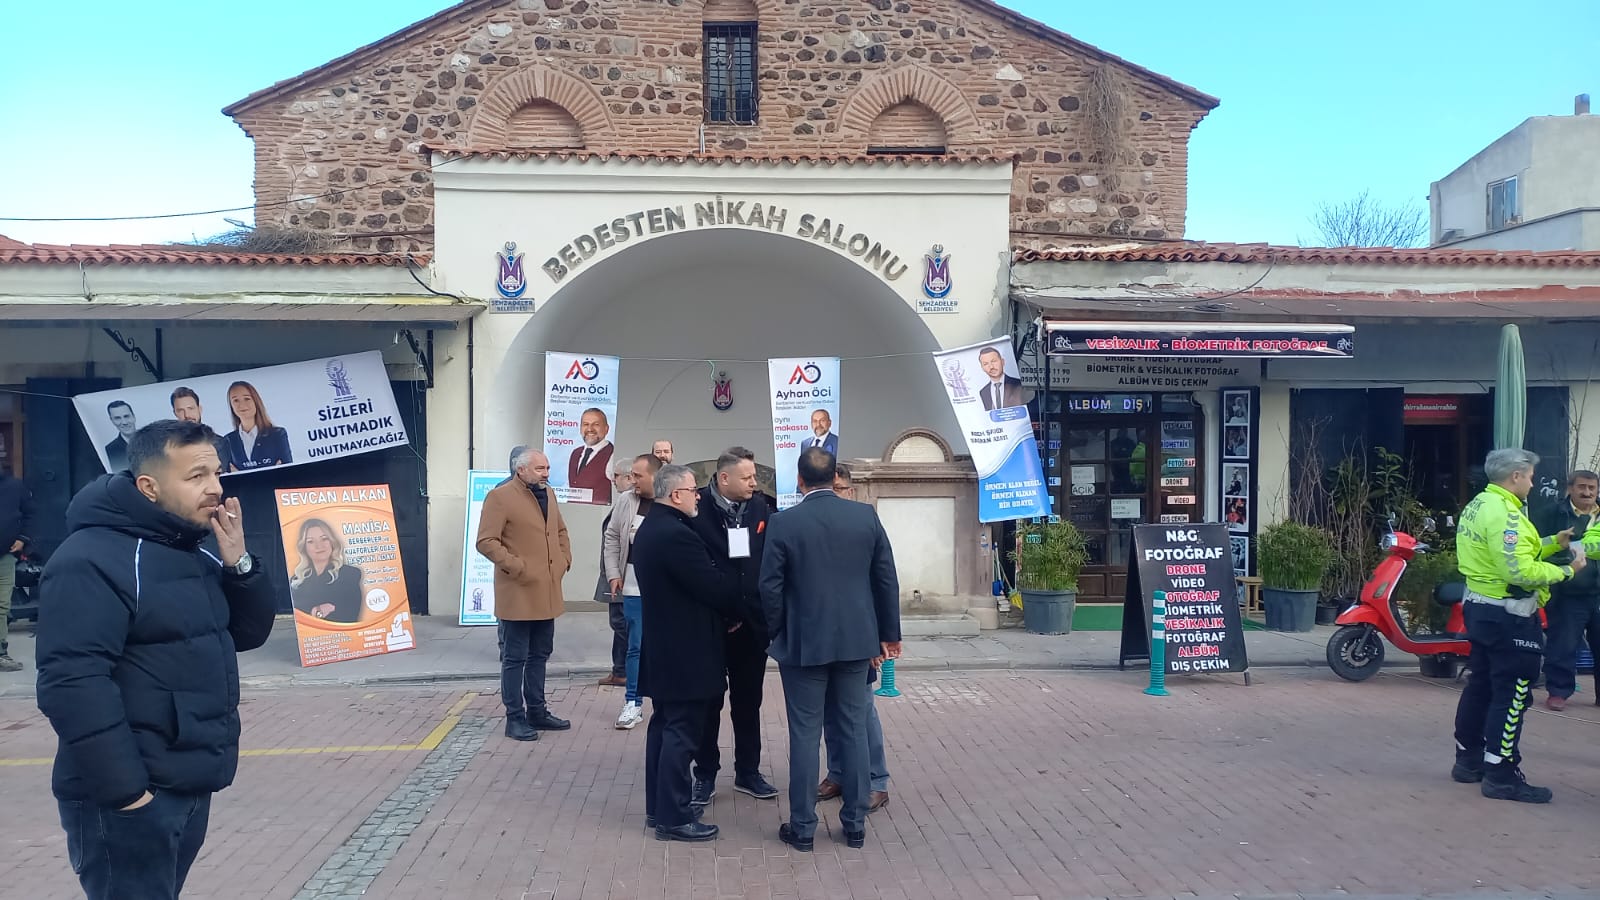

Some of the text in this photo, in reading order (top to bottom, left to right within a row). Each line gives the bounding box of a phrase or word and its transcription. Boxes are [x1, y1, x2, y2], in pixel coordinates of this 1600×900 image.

[541, 194, 908, 284] BEDESTEN NİKAH SALONU
[1086, 336, 1160, 350] VESİKALIK
[1172, 337, 1250, 350] BİOMETRİK
[1252, 338, 1328, 350] FOTOĞRAF
[1086, 364, 1136, 373] BİOMETRİK
[1146, 366, 1192, 374] VESİKALIK
[1195, 366, 1239, 376] FOTOĞRAF
[1118, 376, 1149, 385] ALBÜM
[552, 384, 586, 394] Ayhan
[776, 389, 810, 400] Ayhan
[318, 398, 373, 422] SİZLERİ
[308, 416, 394, 442] UNUTMADIK
[548, 419, 578, 427] başkan
[308, 431, 405, 458] UNUTMAYACAĞIZ
[547, 437, 573, 446] vizyon
[281, 488, 386, 506] SEVCAN ALKAN
[342, 520, 391, 535] MANİSA
[1166, 530, 1197, 542] N&G
[1145, 545, 1223, 561] FOTOĞRAF
[1166, 564, 1206, 575] DRONE
[1171, 576, 1205, 588] VİDEO
[1166, 589, 1220, 603] OTOĞRAF
[1165, 616, 1225, 630] VESİKALIK
[1166, 630, 1226, 643] FOTOĞRAF
[1178, 644, 1219, 657] ALBÜM
[1171, 657, 1229, 671] DIŞ ÇEKİM
